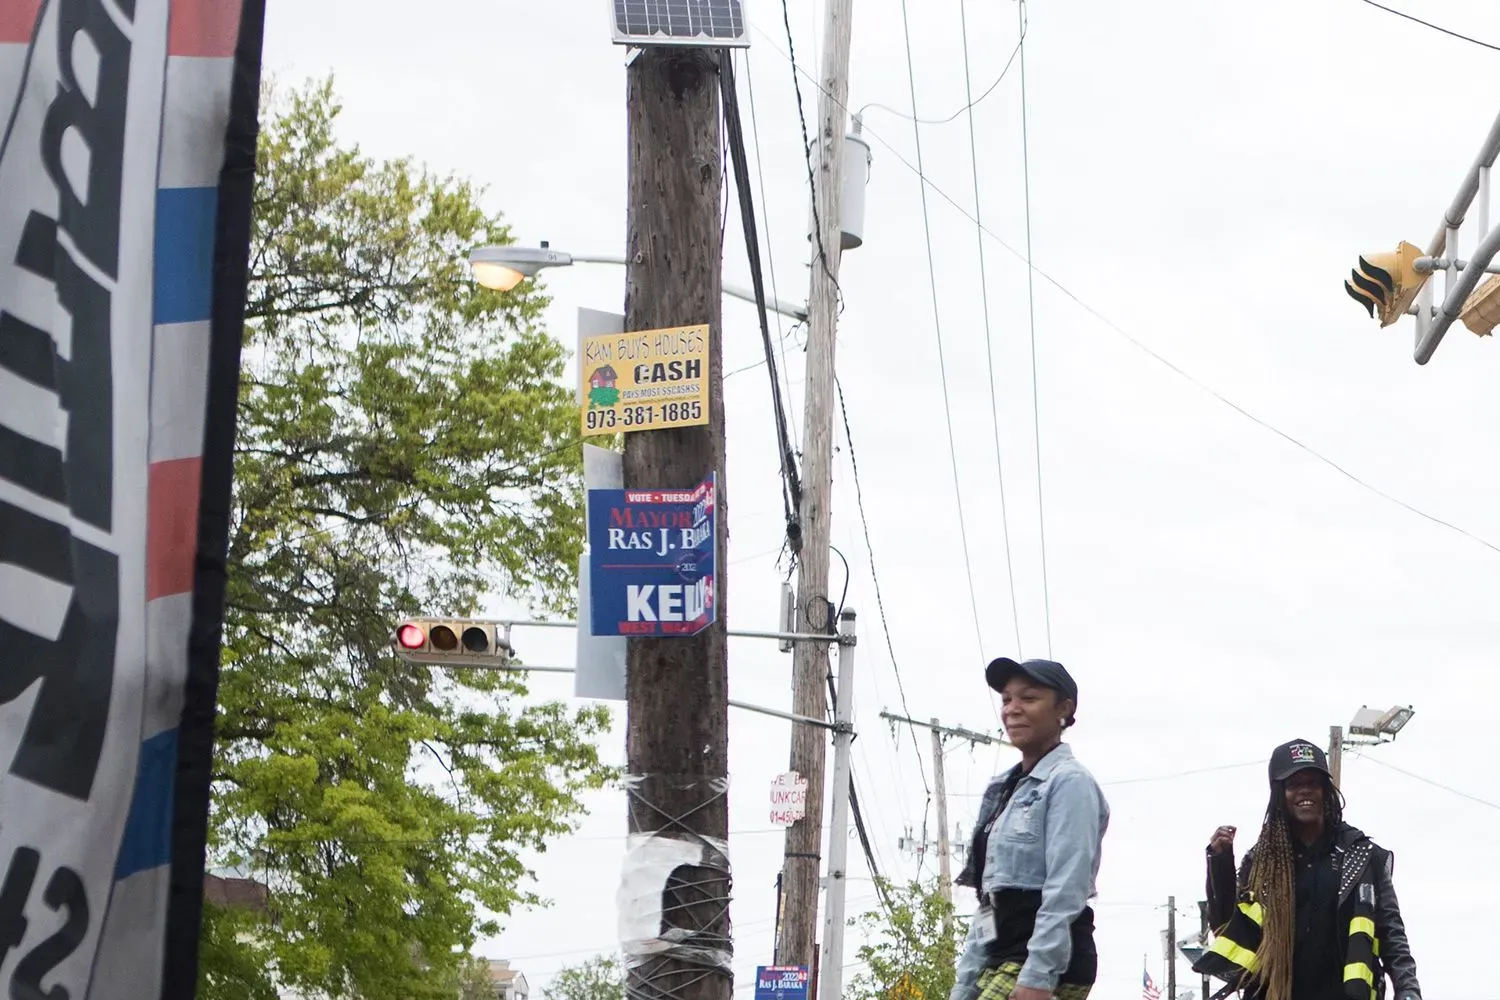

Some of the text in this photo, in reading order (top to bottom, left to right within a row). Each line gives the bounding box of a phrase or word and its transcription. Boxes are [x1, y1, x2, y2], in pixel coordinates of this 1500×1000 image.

[618, 335, 650, 361] BUYS
[654, 328, 704, 356] HOUSES
[633, 358, 701, 385] CASH
[586, 400, 702, 430] 973-381-1885
[628, 493, 652, 503] VOTE
[609, 507, 693, 529] MAYOR
[656, 528, 676, 556] J.
